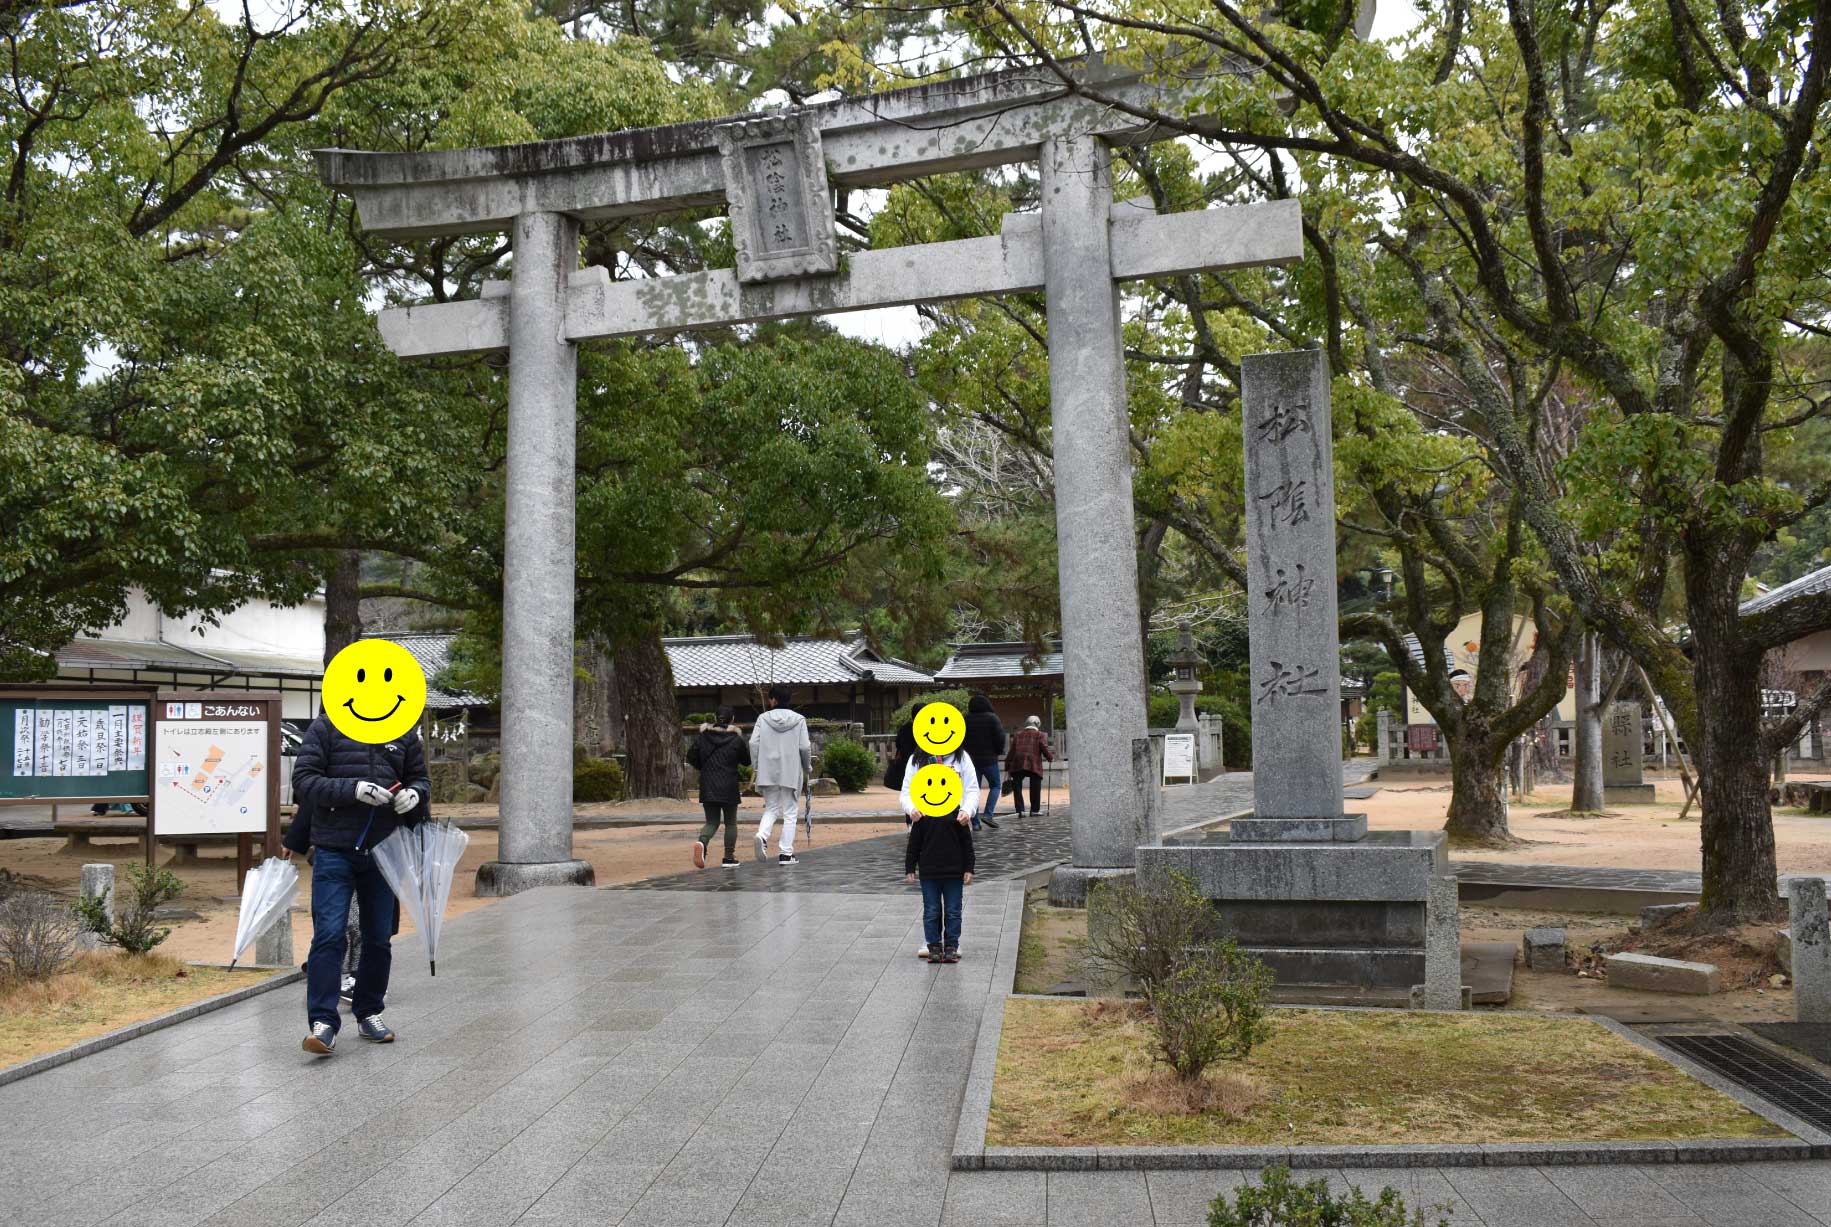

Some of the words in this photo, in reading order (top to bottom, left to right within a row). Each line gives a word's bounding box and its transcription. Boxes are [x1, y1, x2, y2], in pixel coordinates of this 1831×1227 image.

[1258, 404, 1328, 705] 松陰神社
[204, 705, 261, 717] ごあんない
